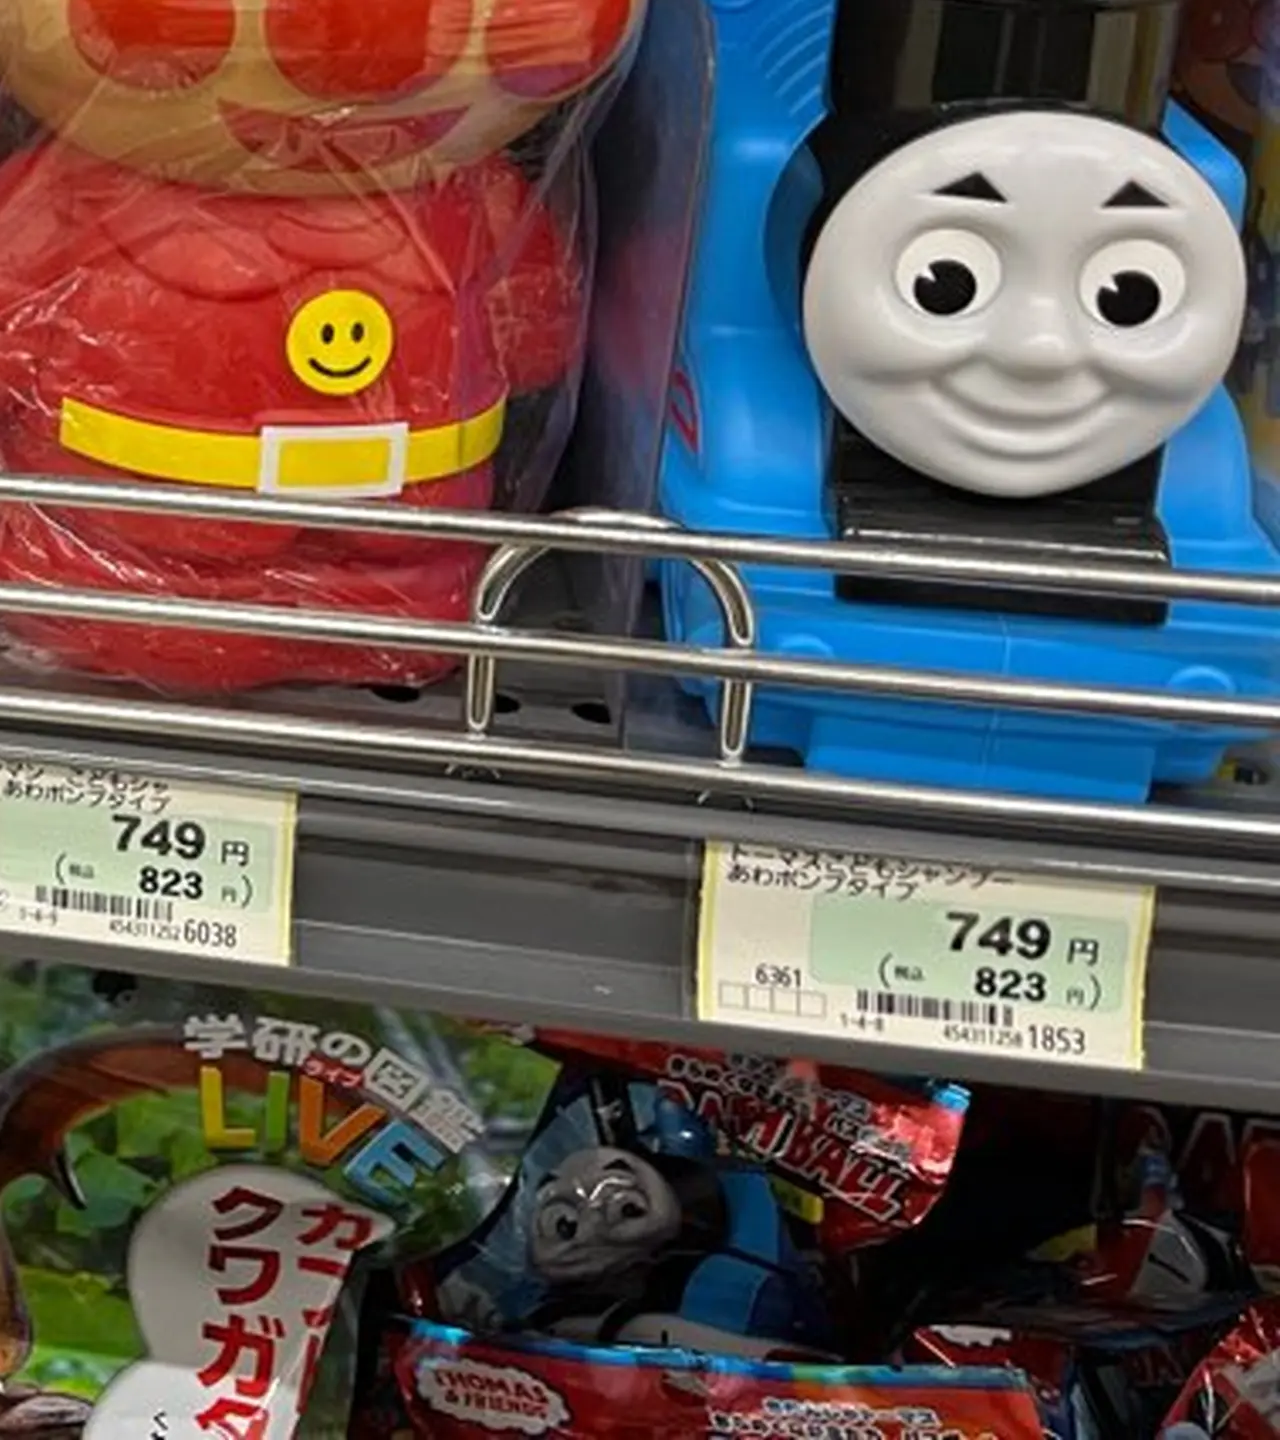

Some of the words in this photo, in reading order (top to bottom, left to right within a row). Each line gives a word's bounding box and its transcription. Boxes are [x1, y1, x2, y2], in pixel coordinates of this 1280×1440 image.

[2, 780, 170, 813] あわポンプタイプ
[139, 867, 202, 899] 823
[727, 863, 918, 900] あわポンプタイプ
[729, 846, 1015, 887] トーマスこどもシャンプー
[755, 964, 801, 987] 6361
[975, 968, 1047, 1003] 823
[184, 1013, 485, 1155] 学研の図鑑
[303, 1059, 364, 1087] ライブ
[199, 1065, 445, 1210] LIVE
